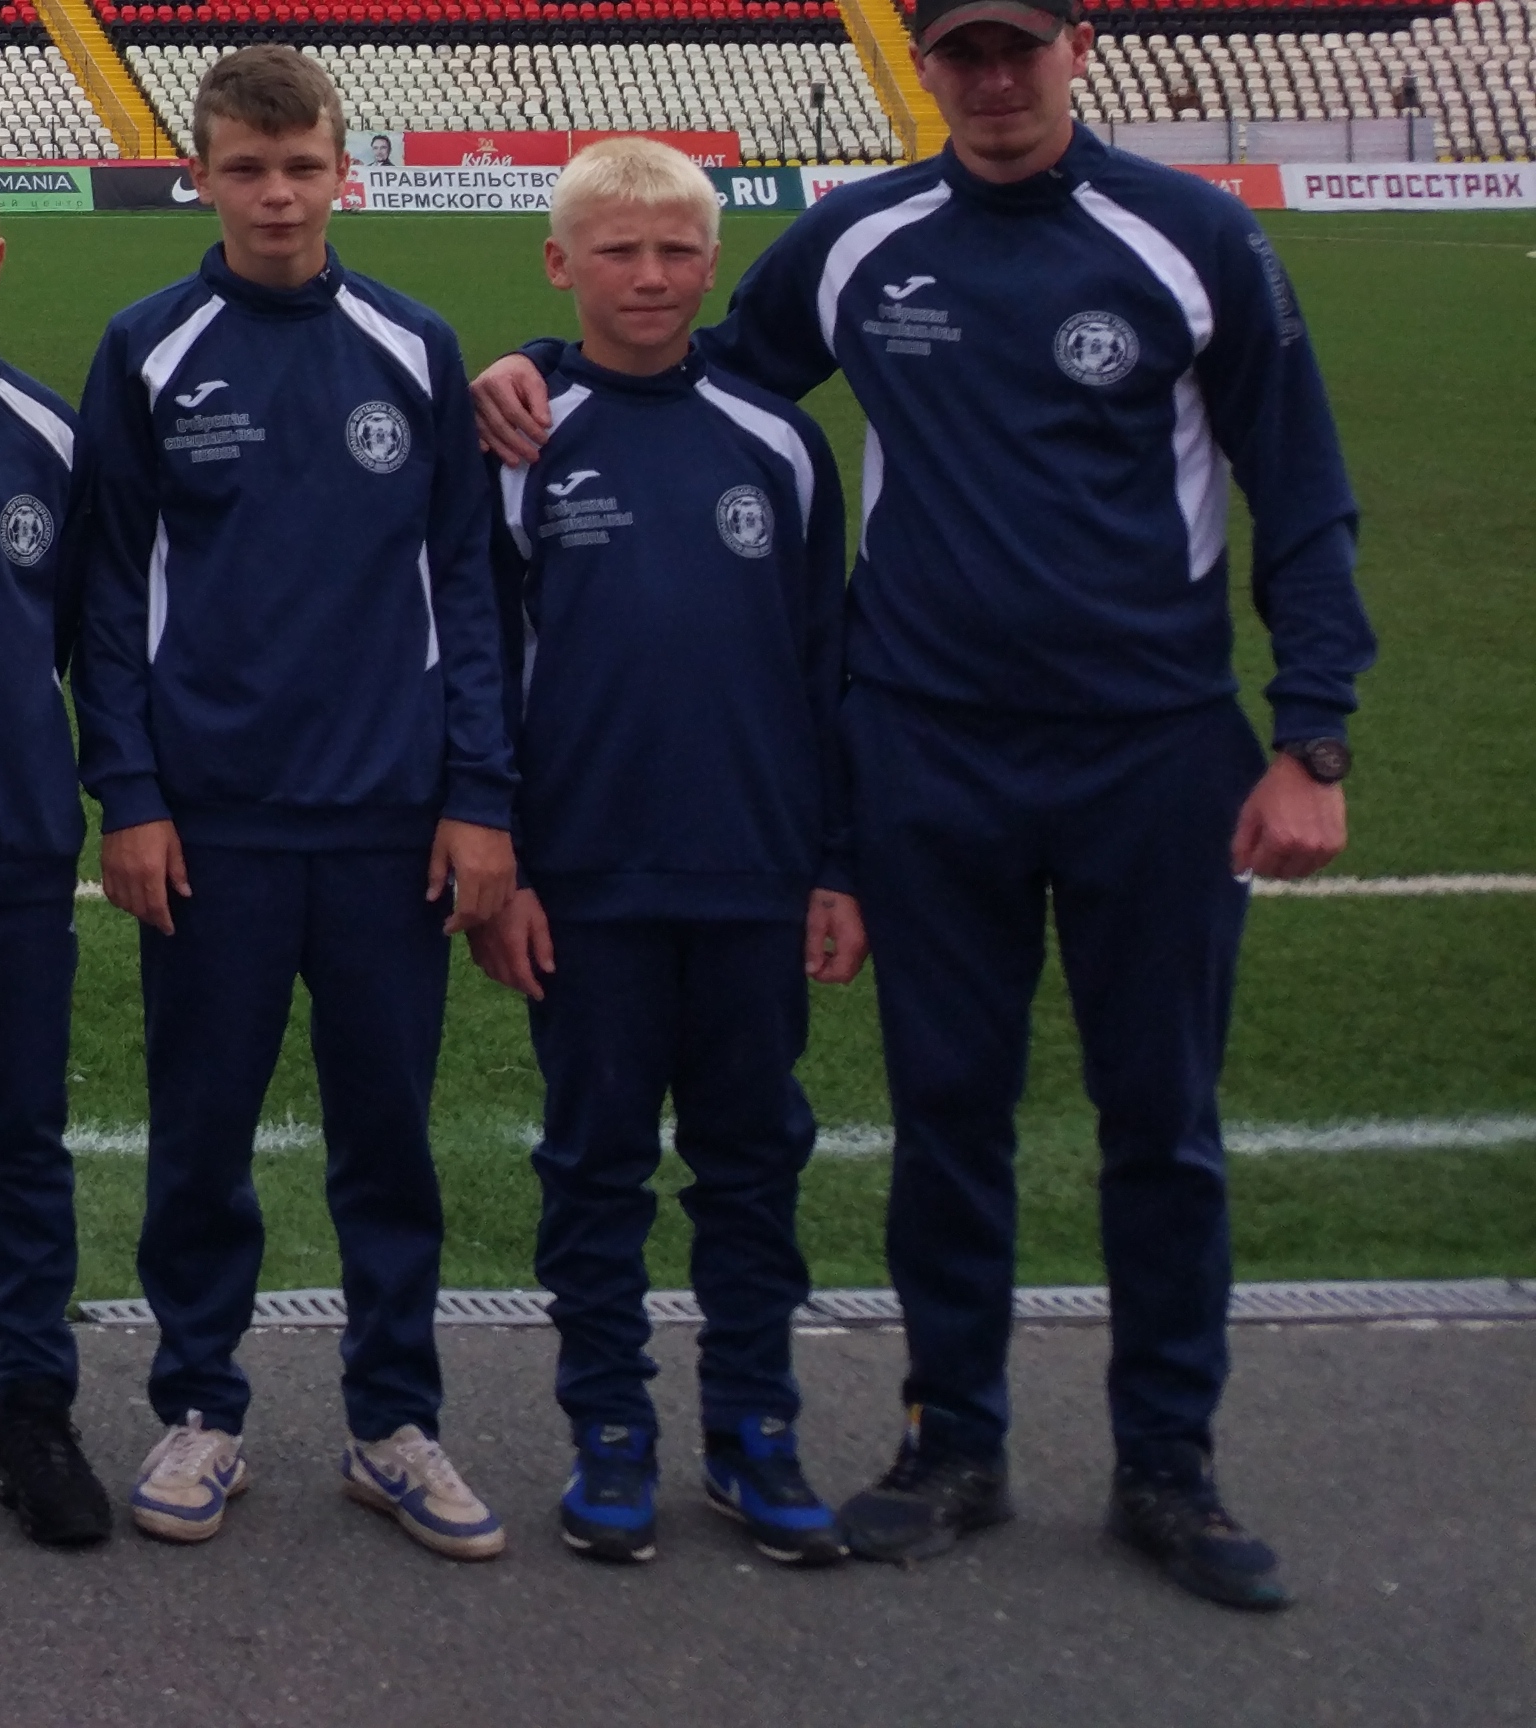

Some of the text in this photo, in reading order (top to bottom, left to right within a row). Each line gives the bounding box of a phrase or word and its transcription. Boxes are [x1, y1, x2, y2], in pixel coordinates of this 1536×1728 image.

[370, 171, 559, 188] ПРАВИТЕЛЬСТВО
[1305, 173, 1524, 199] РОСГОССТРАХ
[372, 193, 554, 209] ПЕРМСКОГО КРА
[732, 177, 778, 206] RU
